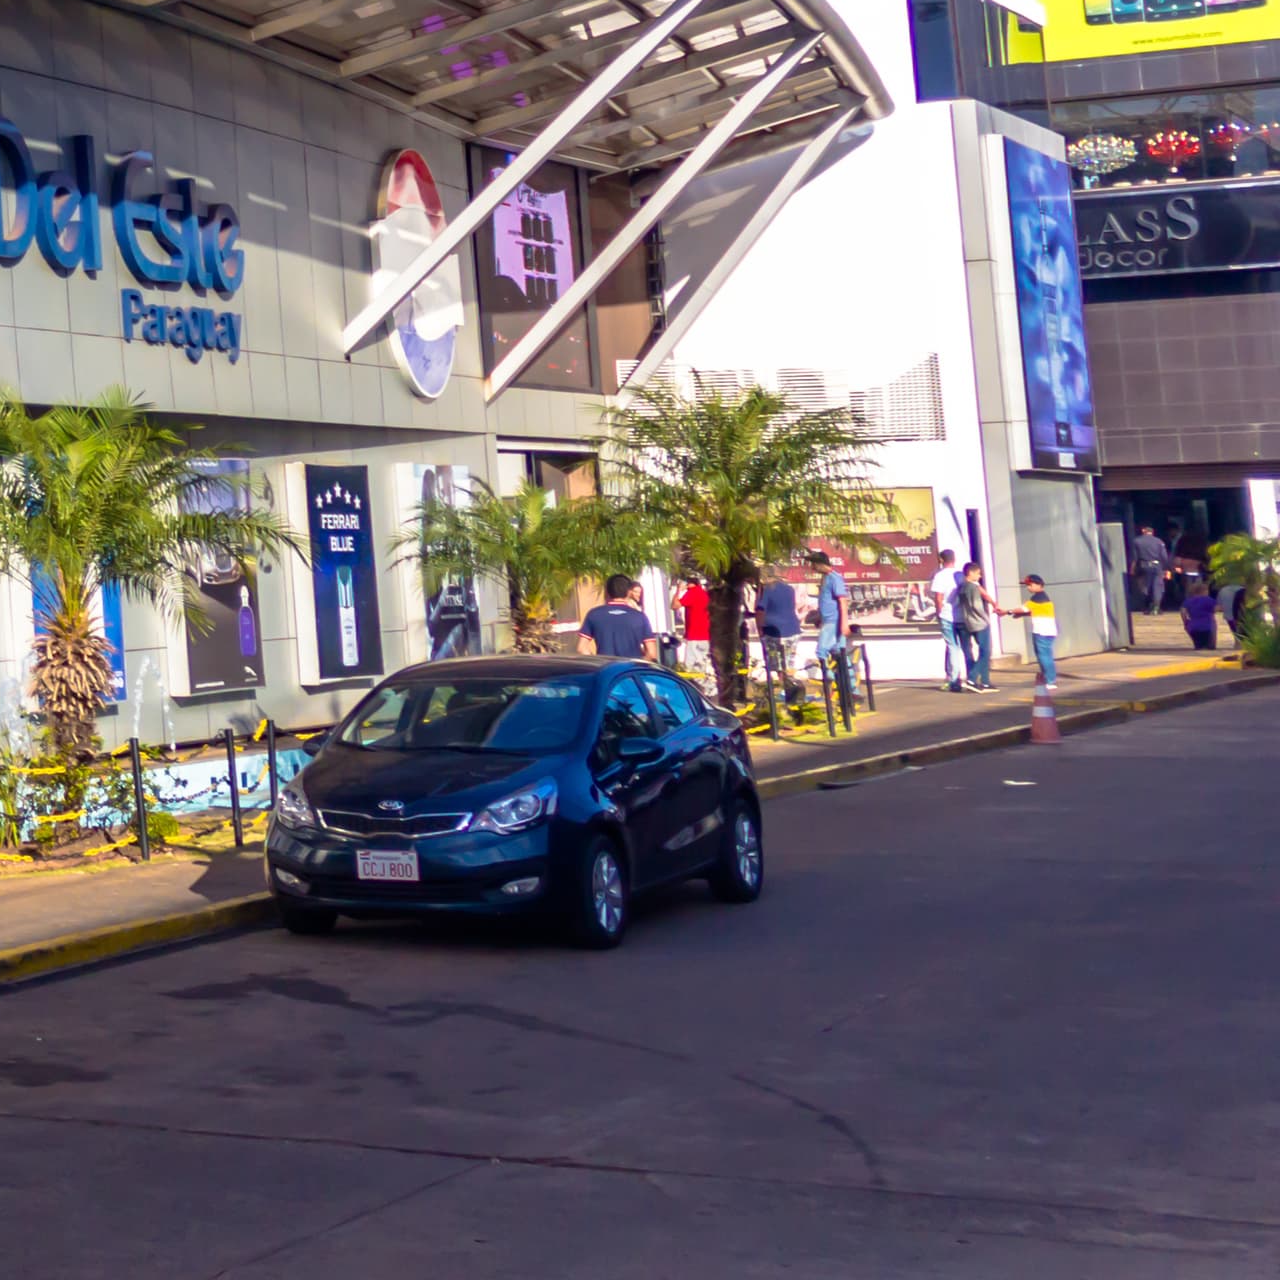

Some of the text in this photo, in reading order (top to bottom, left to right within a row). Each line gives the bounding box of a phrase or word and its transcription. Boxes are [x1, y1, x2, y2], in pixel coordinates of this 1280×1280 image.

[110, 150, 244, 292] Este
[1079, 196, 1199, 245] ASS
[121, 288, 241, 365] Paraguay
[321, 514, 360, 530] FERRARI
[330, 536, 355, 552] BLUE
[363, 862, 386, 877] CCJ
